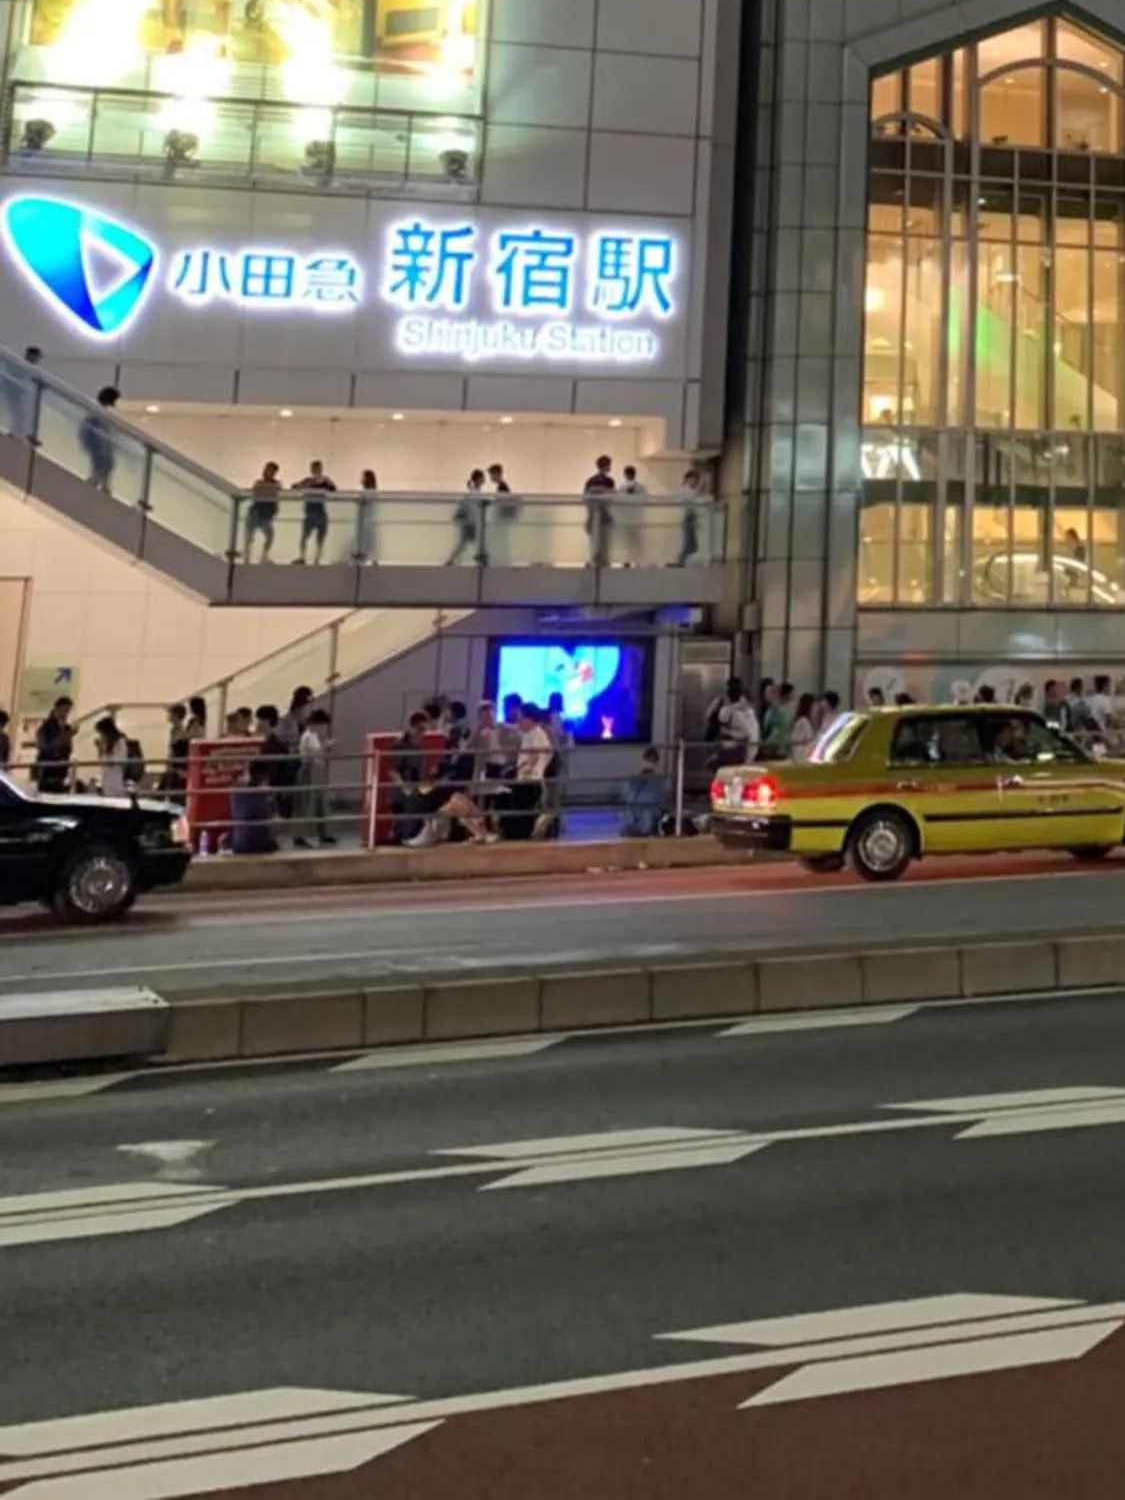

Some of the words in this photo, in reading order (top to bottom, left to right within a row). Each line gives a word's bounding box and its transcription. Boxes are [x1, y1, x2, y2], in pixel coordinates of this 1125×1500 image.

[174, 250, 360, 304] 小田急
[389, 220, 674, 314] 新宿駅
[402, 319, 538, 360] Shinjuku
[545, 324, 657, 358] Station
